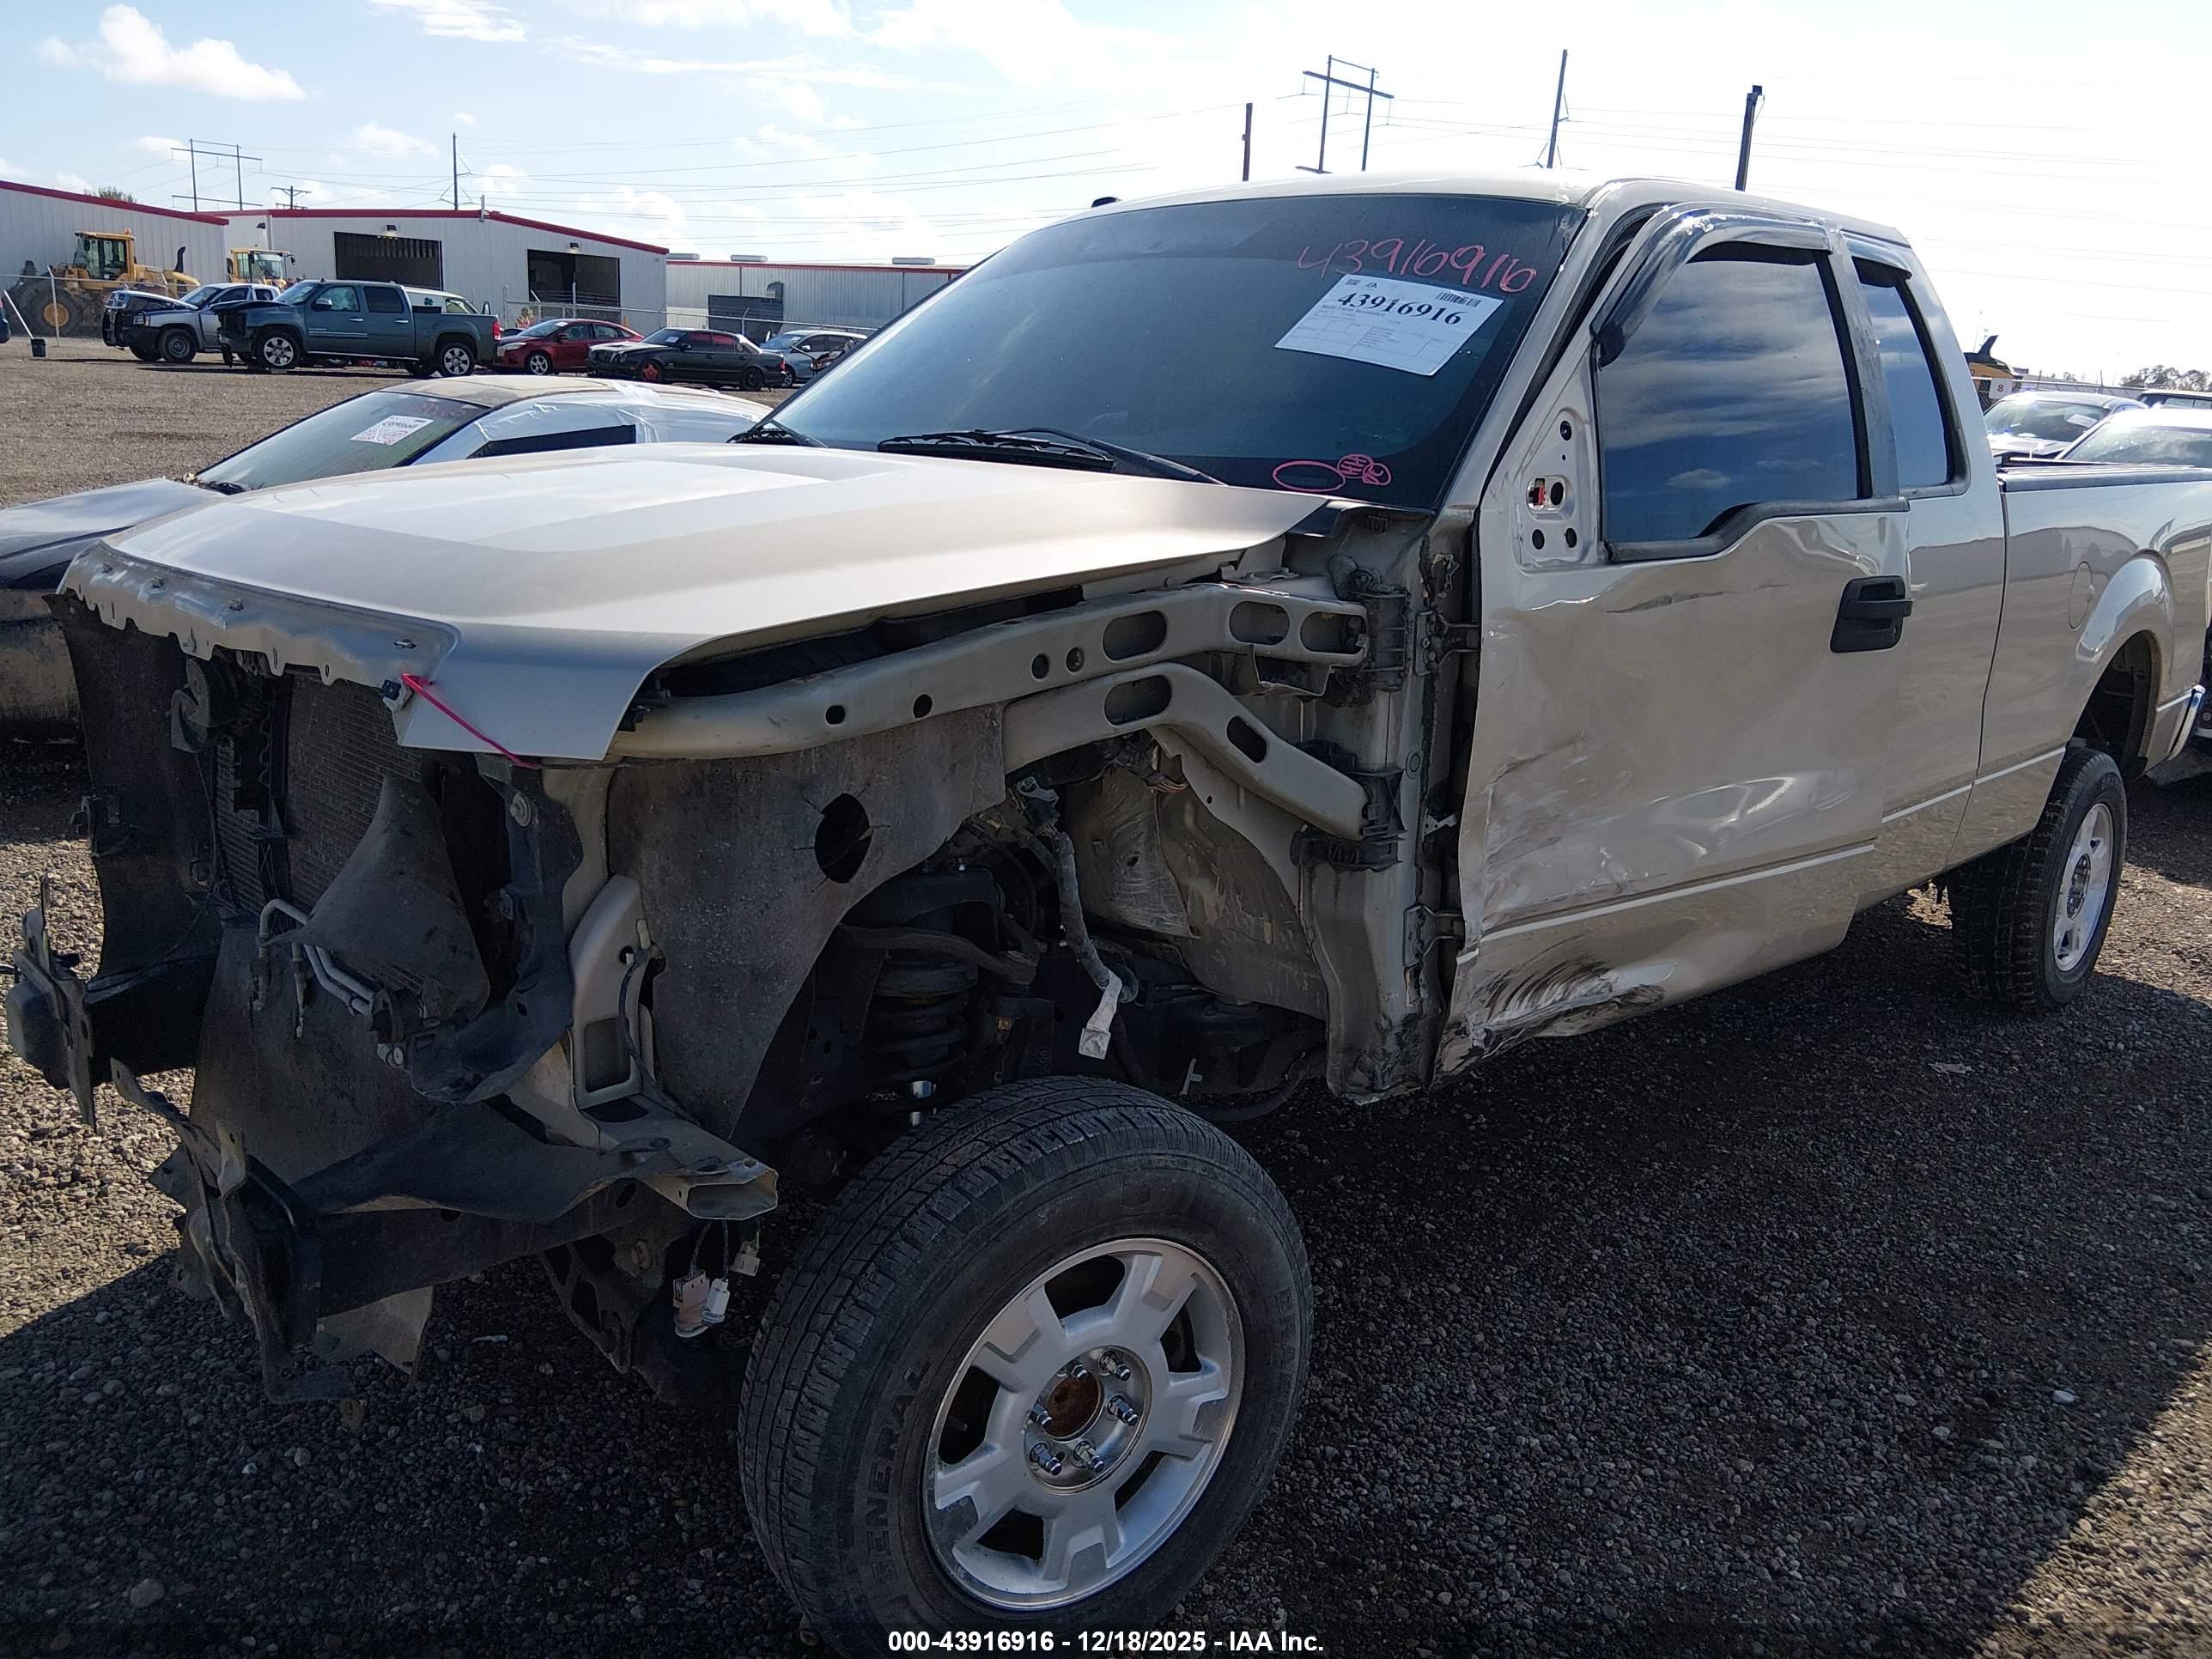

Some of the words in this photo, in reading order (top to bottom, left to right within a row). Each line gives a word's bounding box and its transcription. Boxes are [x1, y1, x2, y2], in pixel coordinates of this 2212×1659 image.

[1297, 238, 1537, 294] 43916916
[1337, 292, 1468, 325] 43916916
[1996, 384, 2004, 392] 8
[865, 1360, 933, 1585] GENERAL
